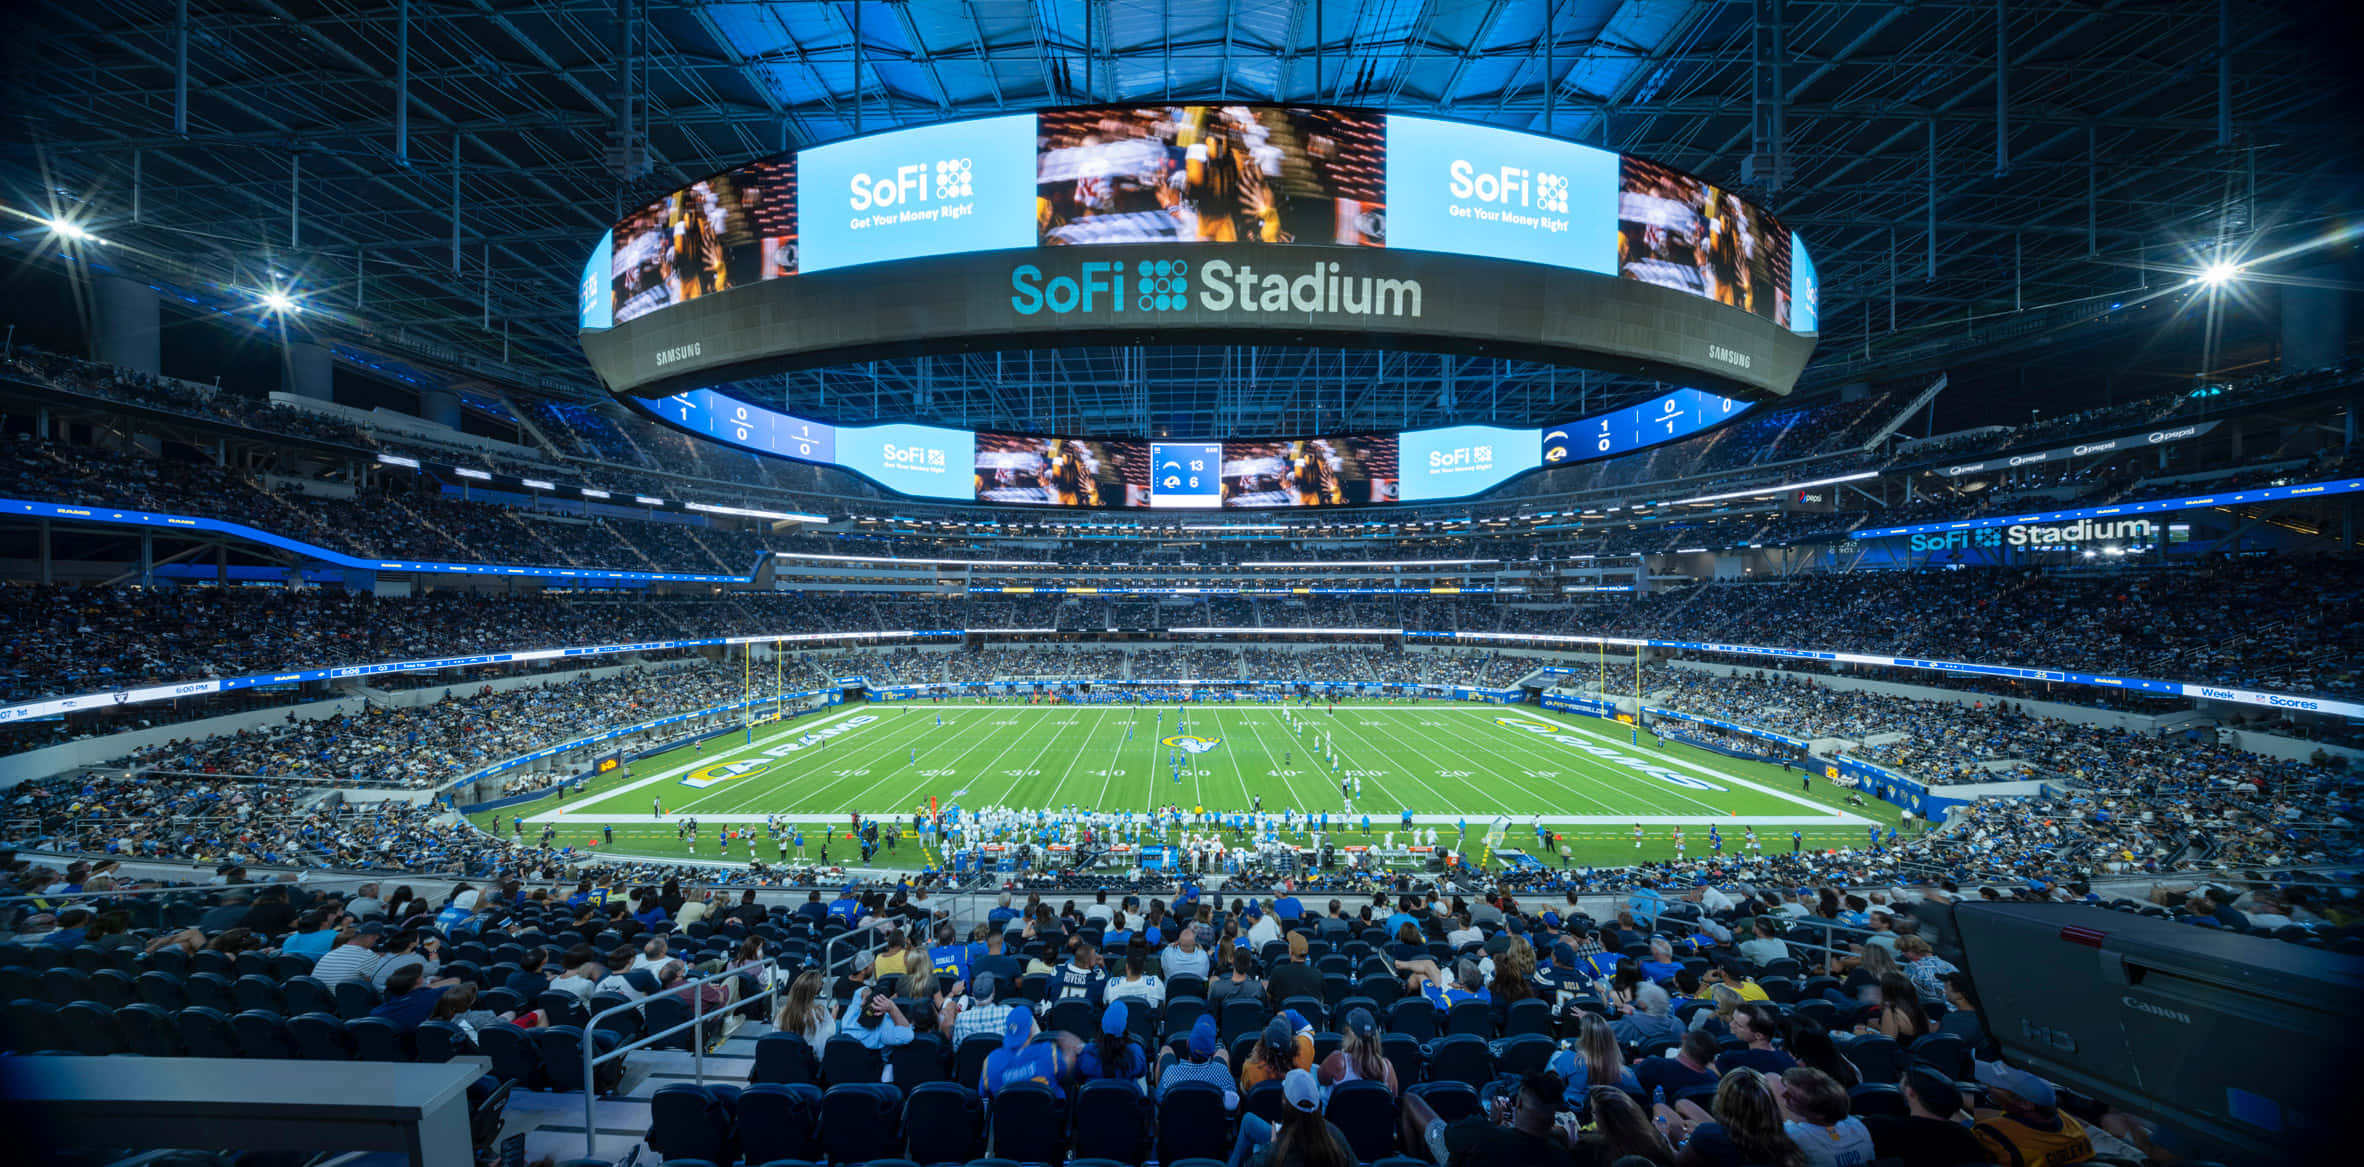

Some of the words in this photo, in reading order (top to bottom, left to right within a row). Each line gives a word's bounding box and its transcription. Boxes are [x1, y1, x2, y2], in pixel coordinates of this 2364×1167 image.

[849, 163, 928, 211] SoFi
[1449, 159, 1529, 207] SoFi
[850, 217, 871, 230] Get
[872, 214, 898, 226] Your
[899, 209, 940, 222] Money
[940, 203, 973, 219] Right
[1449, 204, 1472, 218] Get
[1473, 207, 1499, 221] Your
[1501, 210, 1540, 230] Money
[1540, 216, 1569, 233] Right
[1011, 260, 1125, 315] SoFi
[1200, 259, 1422, 317] Stadium
[656, 342, 701, 366] SAMSUNG
[1708, 344, 1751, 369] SAMSUNG
[1664, 399, 1676, 413] 0
[1722, 398, 1732, 413] 0
[680, 406, 688, 421] 1
[736, 407, 748, 420] 0
[801, 425, 809, 437] 1
[1600, 419, 1609, 432] 1
[1666, 420, 1674, 434] 1
[736, 427, 748, 441] 0
[2164, 427, 2196, 440] pepsi
[800, 443, 811, 455] 0
[1598, 438, 1611, 451] 0
[2087, 442, 2116, 454] pepsi
[883, 444, 925, 464] SoFi
[1429, 447, 1470, 467] SoFi
[2021, 453, 2046, 465] pepsi
[1189, 460, 1204, 471] 13
[1189, 476, 1199, 488] 6
[1911, 530, 1969, 551] SoFi
[2008, 519, 2151, 546] Stadium
[175, 686, 194, 695] 6:00
[195, 683, 209, 693] PM
[2200, 687, 2235, 700] Week
[2269, 695, 2319, 710] Scores
[17, 708, 28, 717] 1st
[1063, 971, 1087, 985] RIVERS
[2121, 996, 2192, 1025] Canon
